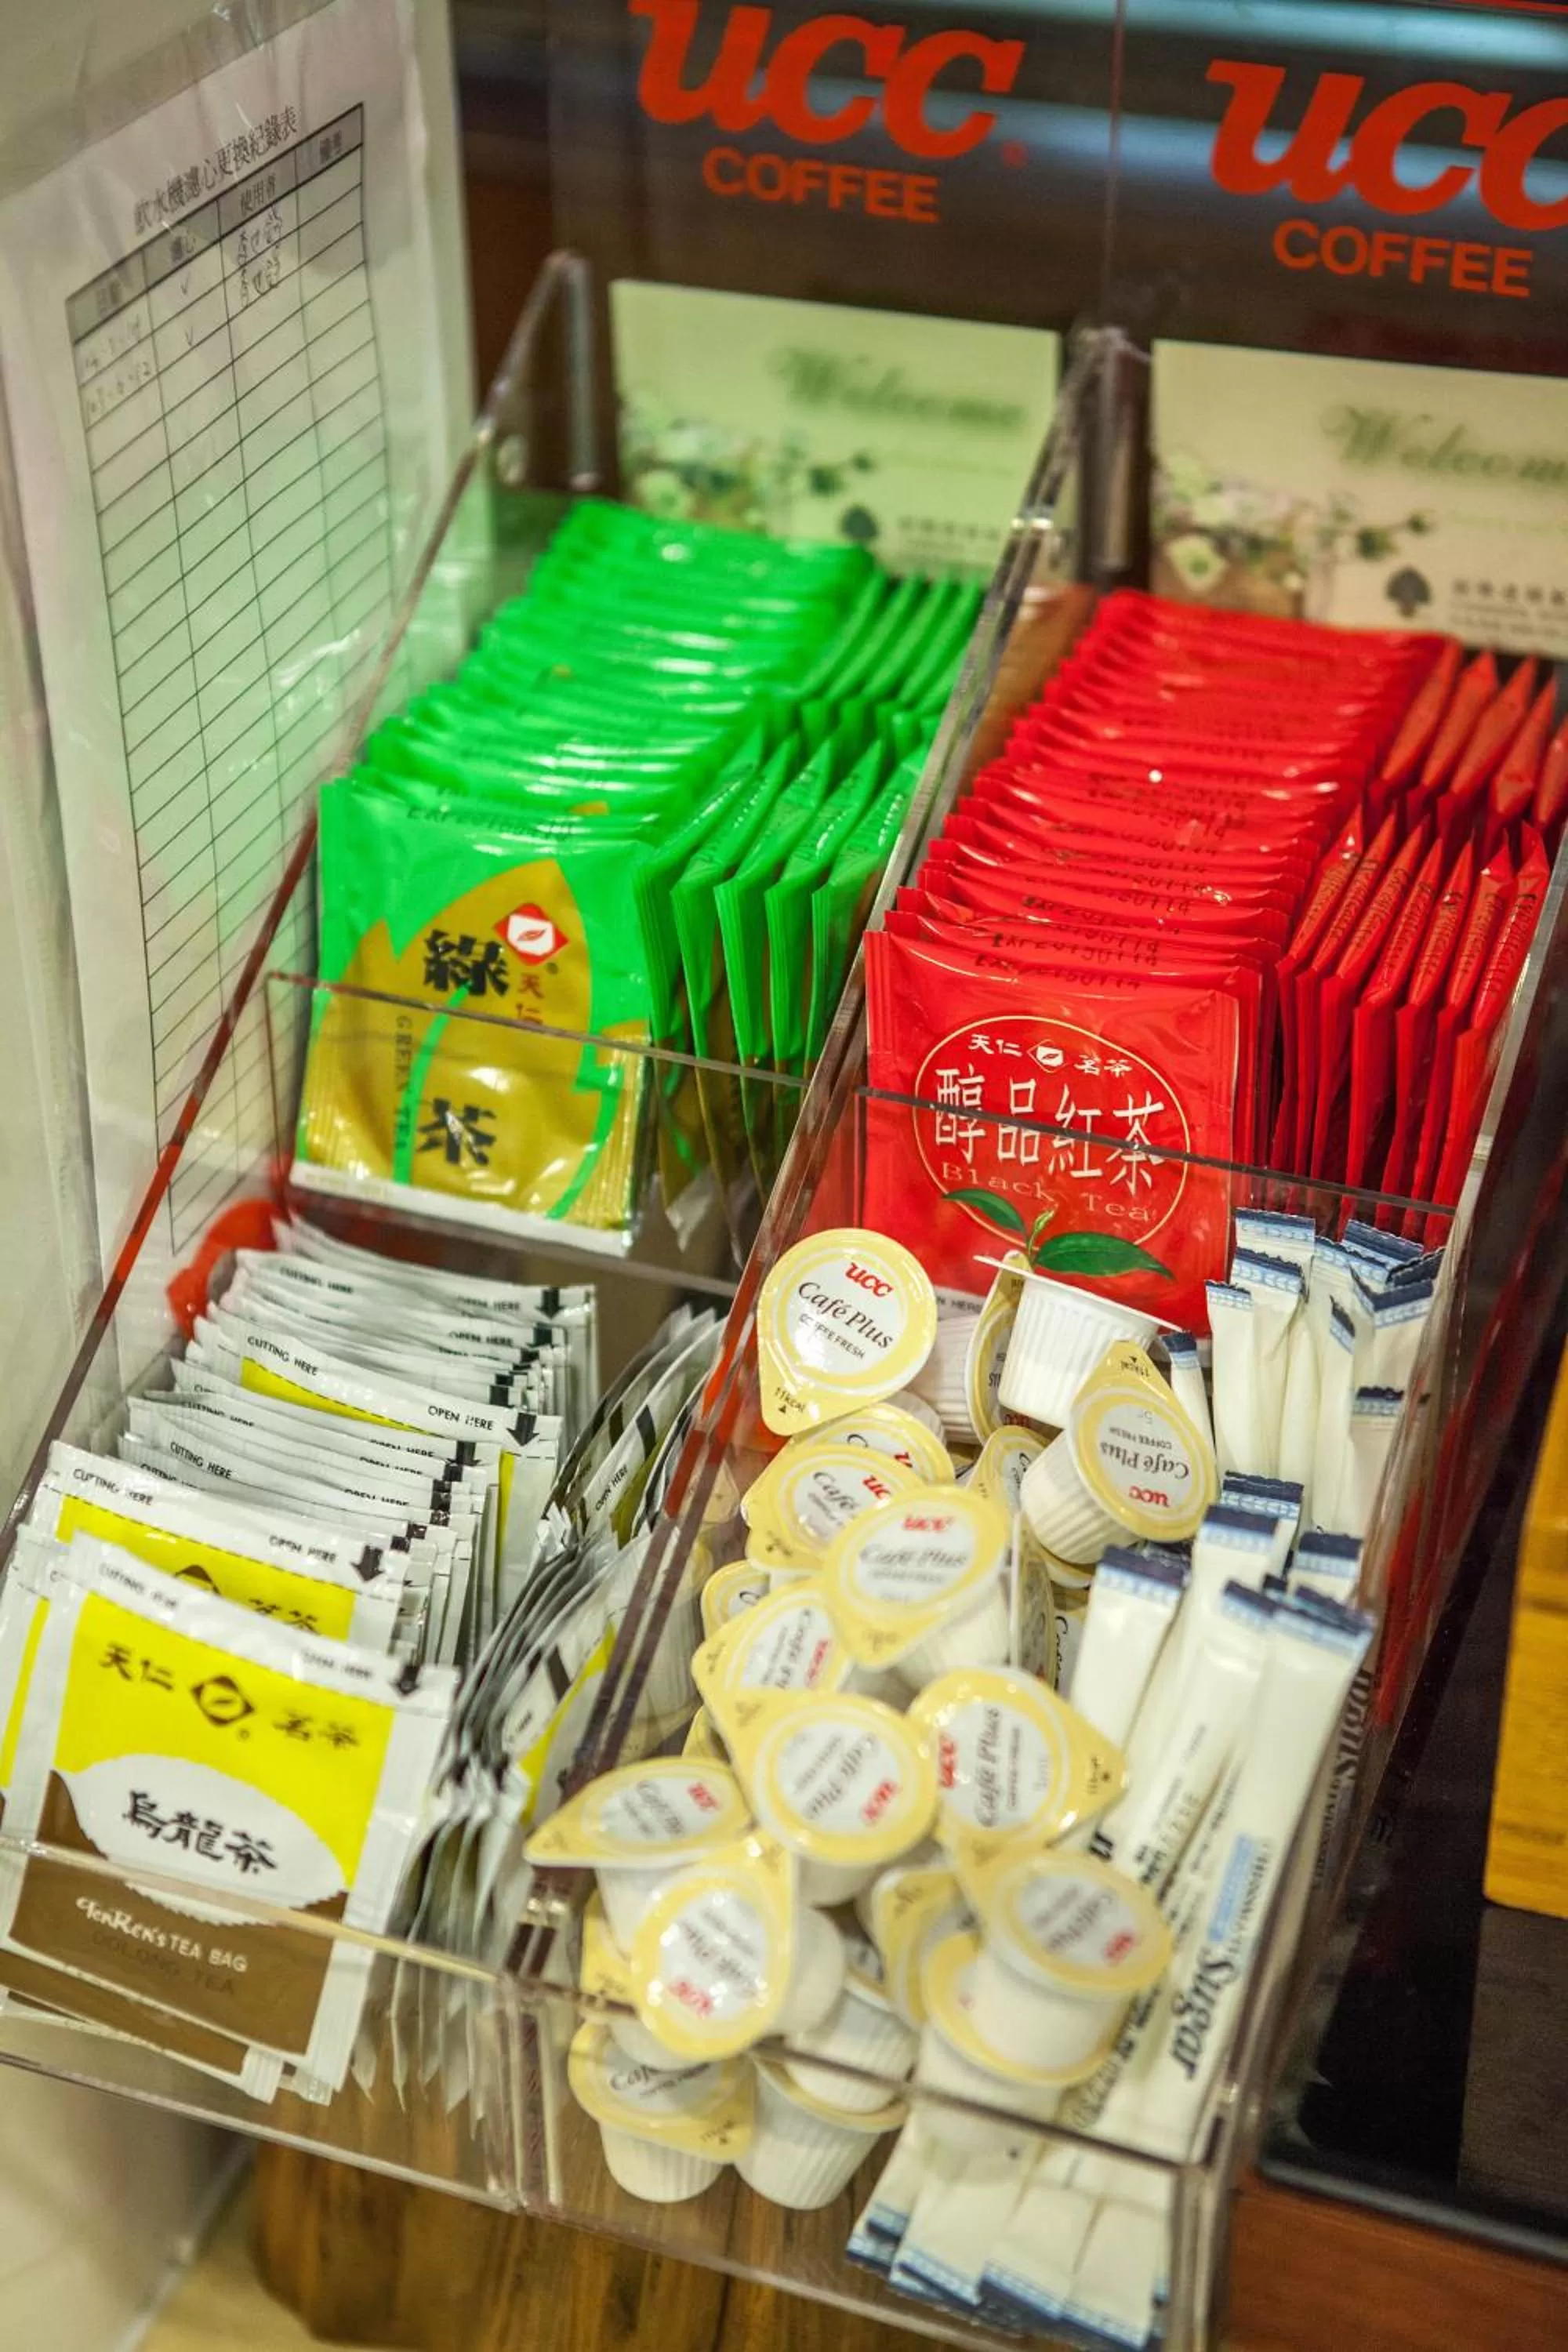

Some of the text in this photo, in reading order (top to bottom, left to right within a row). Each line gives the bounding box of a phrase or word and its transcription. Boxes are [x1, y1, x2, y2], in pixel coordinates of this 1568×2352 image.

[703, 147, 940, 223] COFFEE
[1272, 219, 1533, 299] COFFEE
[967, 1033, 1023, 1058] 天仁
[1073, 1054, 1134, 1077] 茗茶
[934, 1063, 1166, 1196] 醇品紅茶
[942, 1162, 1156, 1223] Black Tea
[798, 1281, 894, 1350] Café Plus
[247, 1335, 319, 1377] CUTTING HERE
[834, 1334, 866, 1360] FRESH
[428, 1405, 460, 1424] OPEN
[170, 1441, 204, 1467] CUTTING
[207, 1461, 233, 1480] HERE
[1099, 1441, 1189, 1480] Café Plus
[99, 1642, 174, 1692] 天仁
[122, 1790, 278, 1876] 烏龍茶
[168, 1933, 202, 1960] TEA
[208, 1947, 249, 1973] BAG
[1169, 1950, 1238, 2082] Sugar
